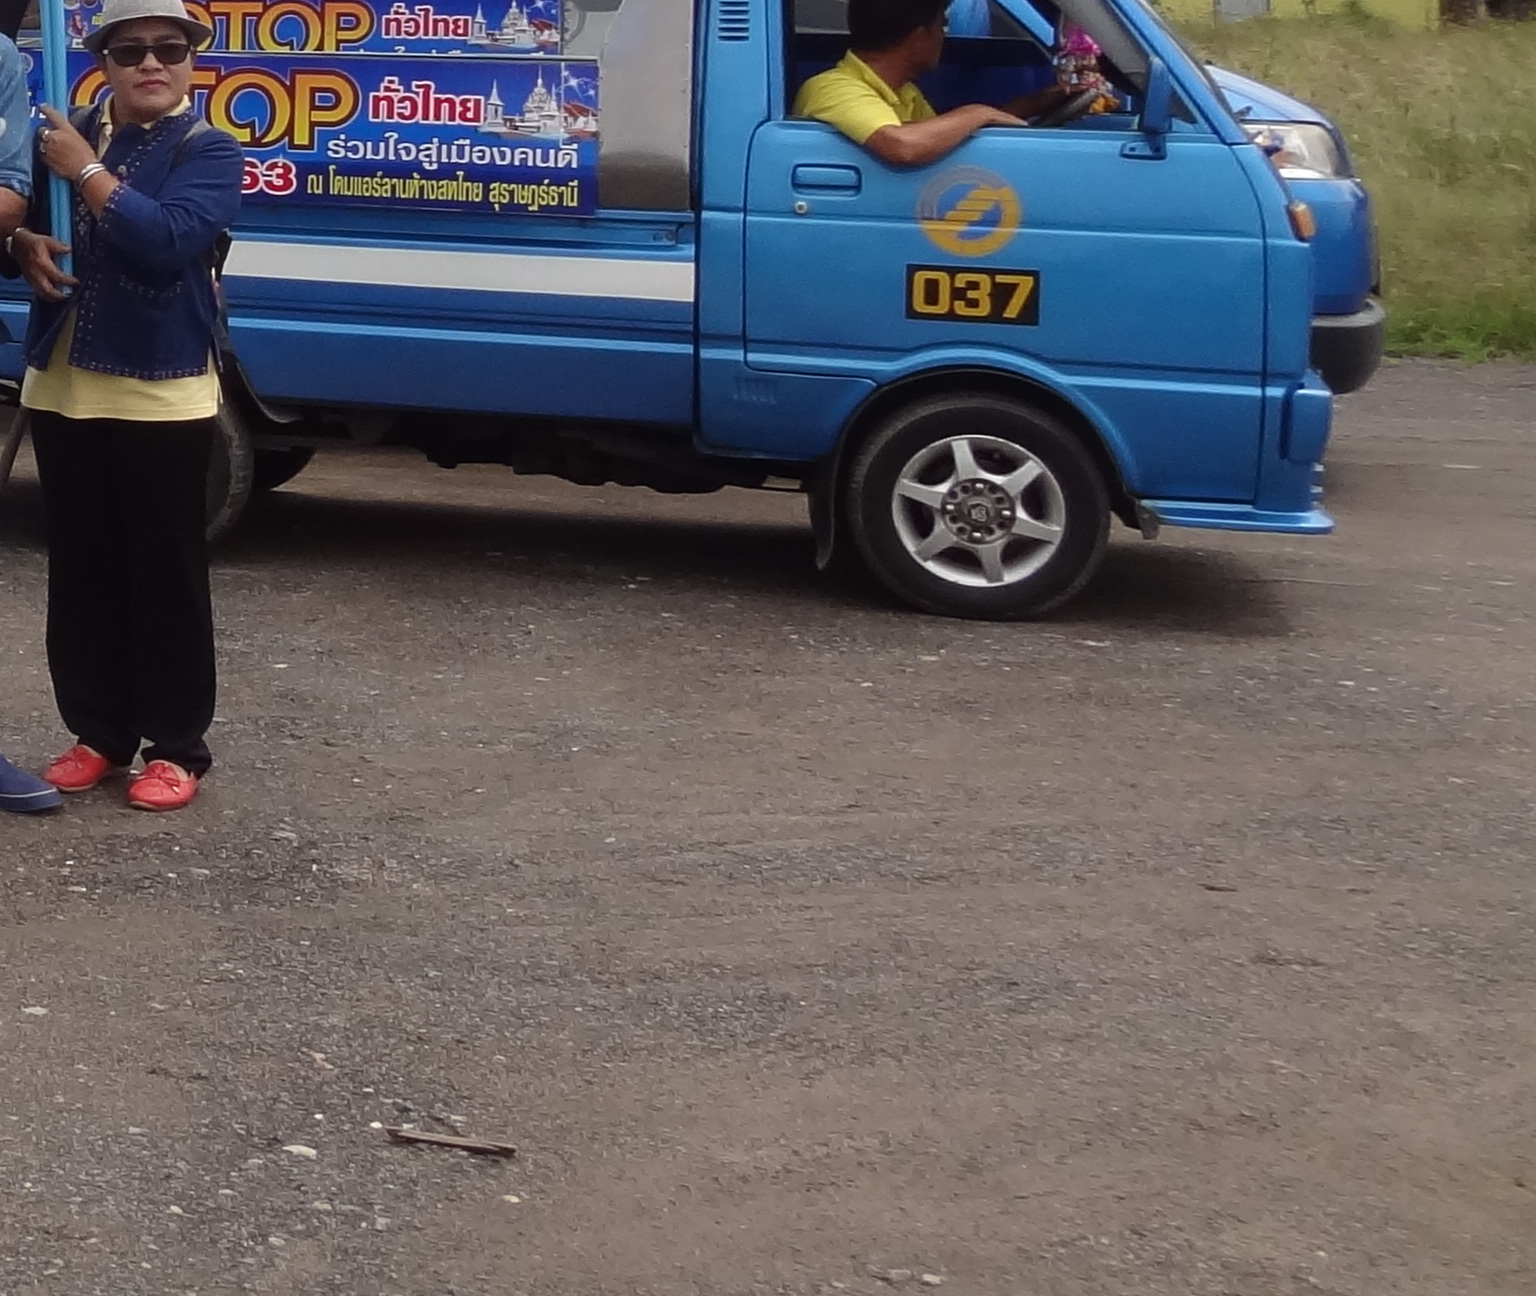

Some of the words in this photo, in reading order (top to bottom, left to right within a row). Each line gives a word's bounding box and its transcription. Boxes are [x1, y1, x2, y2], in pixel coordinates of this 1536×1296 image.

[382, 3, 472, 39] ทั่วไทย
[368, 76, 484, 125] ทั่วไทย
[327, 131, 579, 170] ร่วมใจสู่เมืองคนดี
[307, 174, 323, 195] ณ
[329, 165, 483, 203] โดมแอร์ลานห้างสหไทย
[912, 270, 1035, 319] 037
